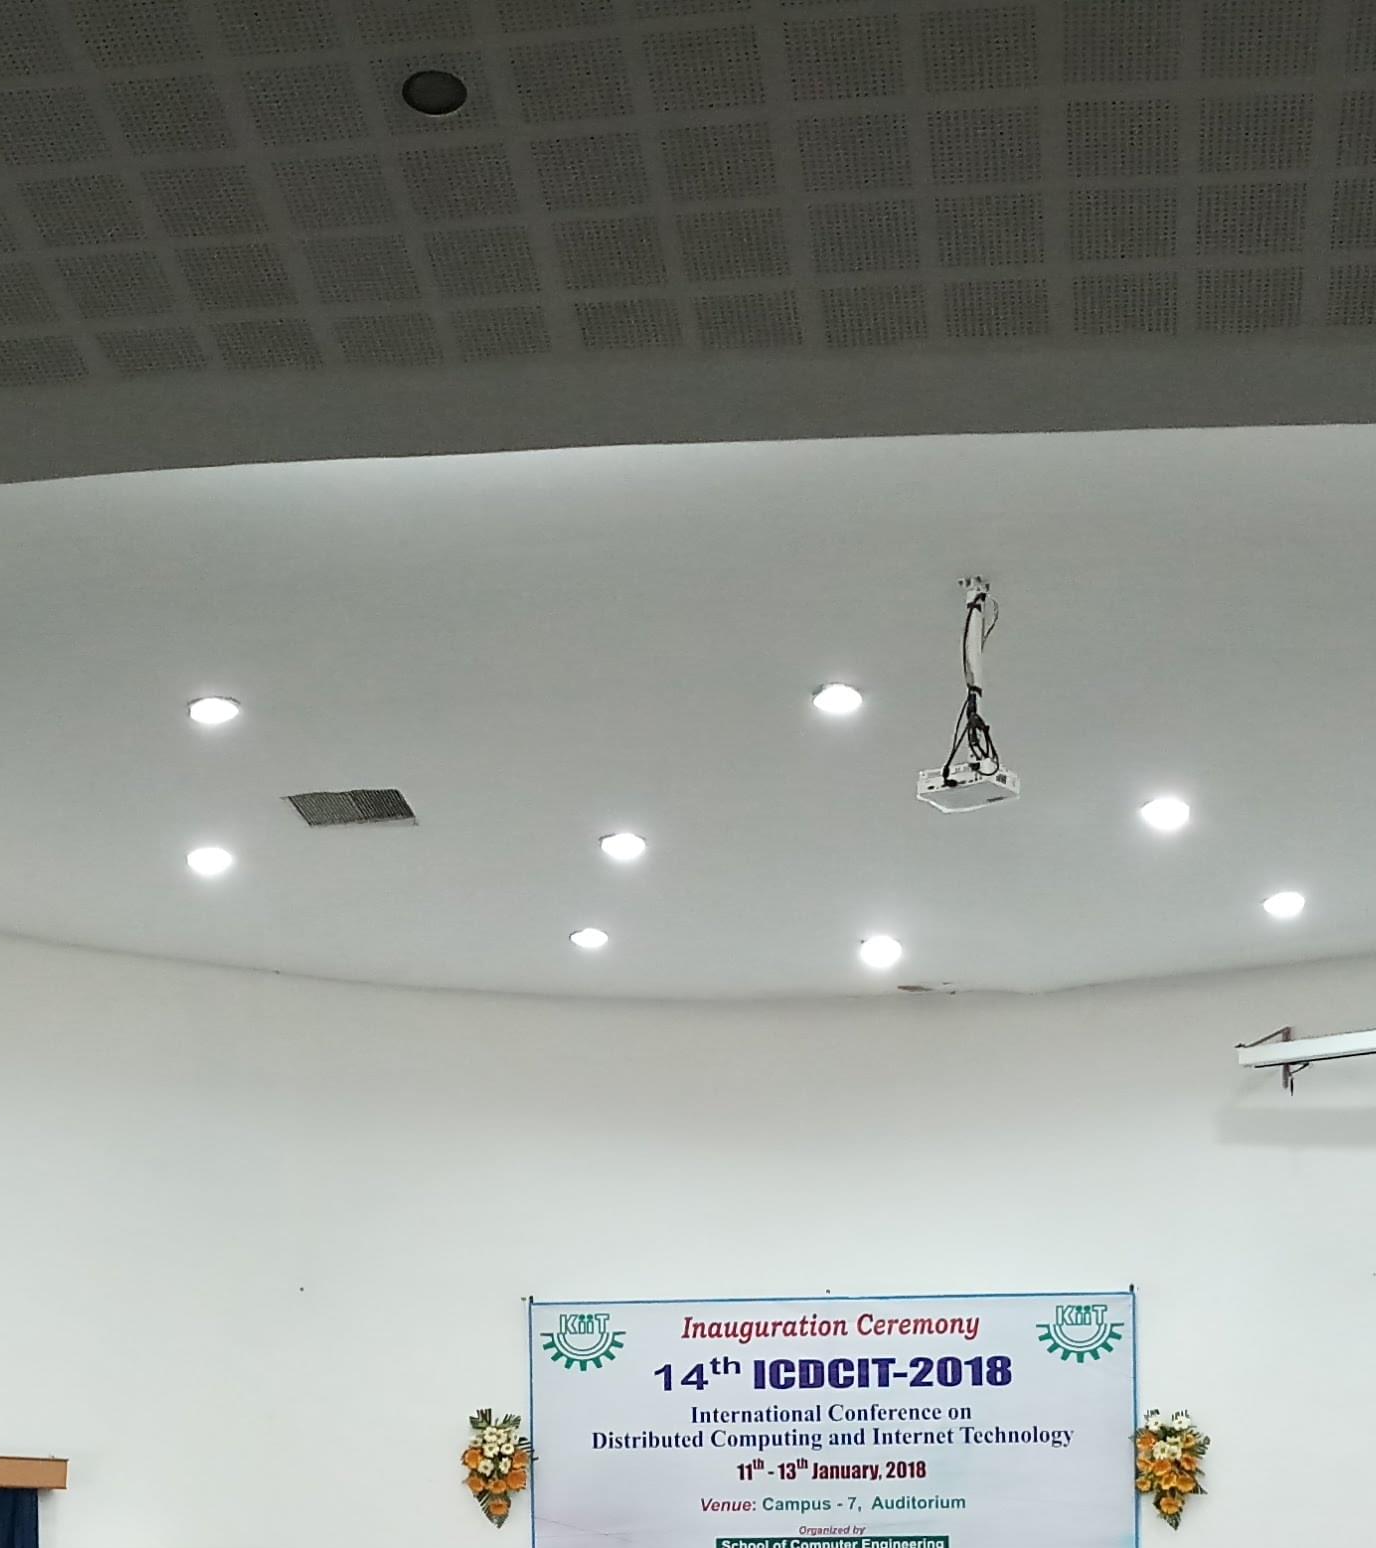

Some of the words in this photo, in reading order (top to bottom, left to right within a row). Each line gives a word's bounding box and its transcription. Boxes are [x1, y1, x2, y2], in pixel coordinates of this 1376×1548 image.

[680, 1312, 849, 1344] Inauguration
[856, 1312, 980, 1341] Ceremony
[654, 1356, 741, 1392] 14th
[753, 1355, 1013, 1391] ICDCIT-2018
[690, 1404, 821, 1424] International
[827, 1403, 942, 1422] Conference
[947, 1406, 972, 1420] on
[591, 1430, 704, 1450] Distributed
[710, 1429, 823, 1451] Computing
[828, 1428, 866, 1446] and
[873, 1427, 955, 1446] Internet
[959, 1425, 1075, 1448] Technology
[736, 1457, 765, 1481] 11th
[777, 1457, 808, 1481] 13th
[811, 1461, 883, 1481] January,
[885, 1460, 927, 1479] 2018
[700, 1497, 757, 1512] Venue:
[762, 1496, 832, 1514] Campus
[847, 1496, 862, 1512] 7,
[871, 1494, 967, 1510] Auditorium
[798, 1525, 850, 1536] Organized
[852, 1525, 866, 1536] by
